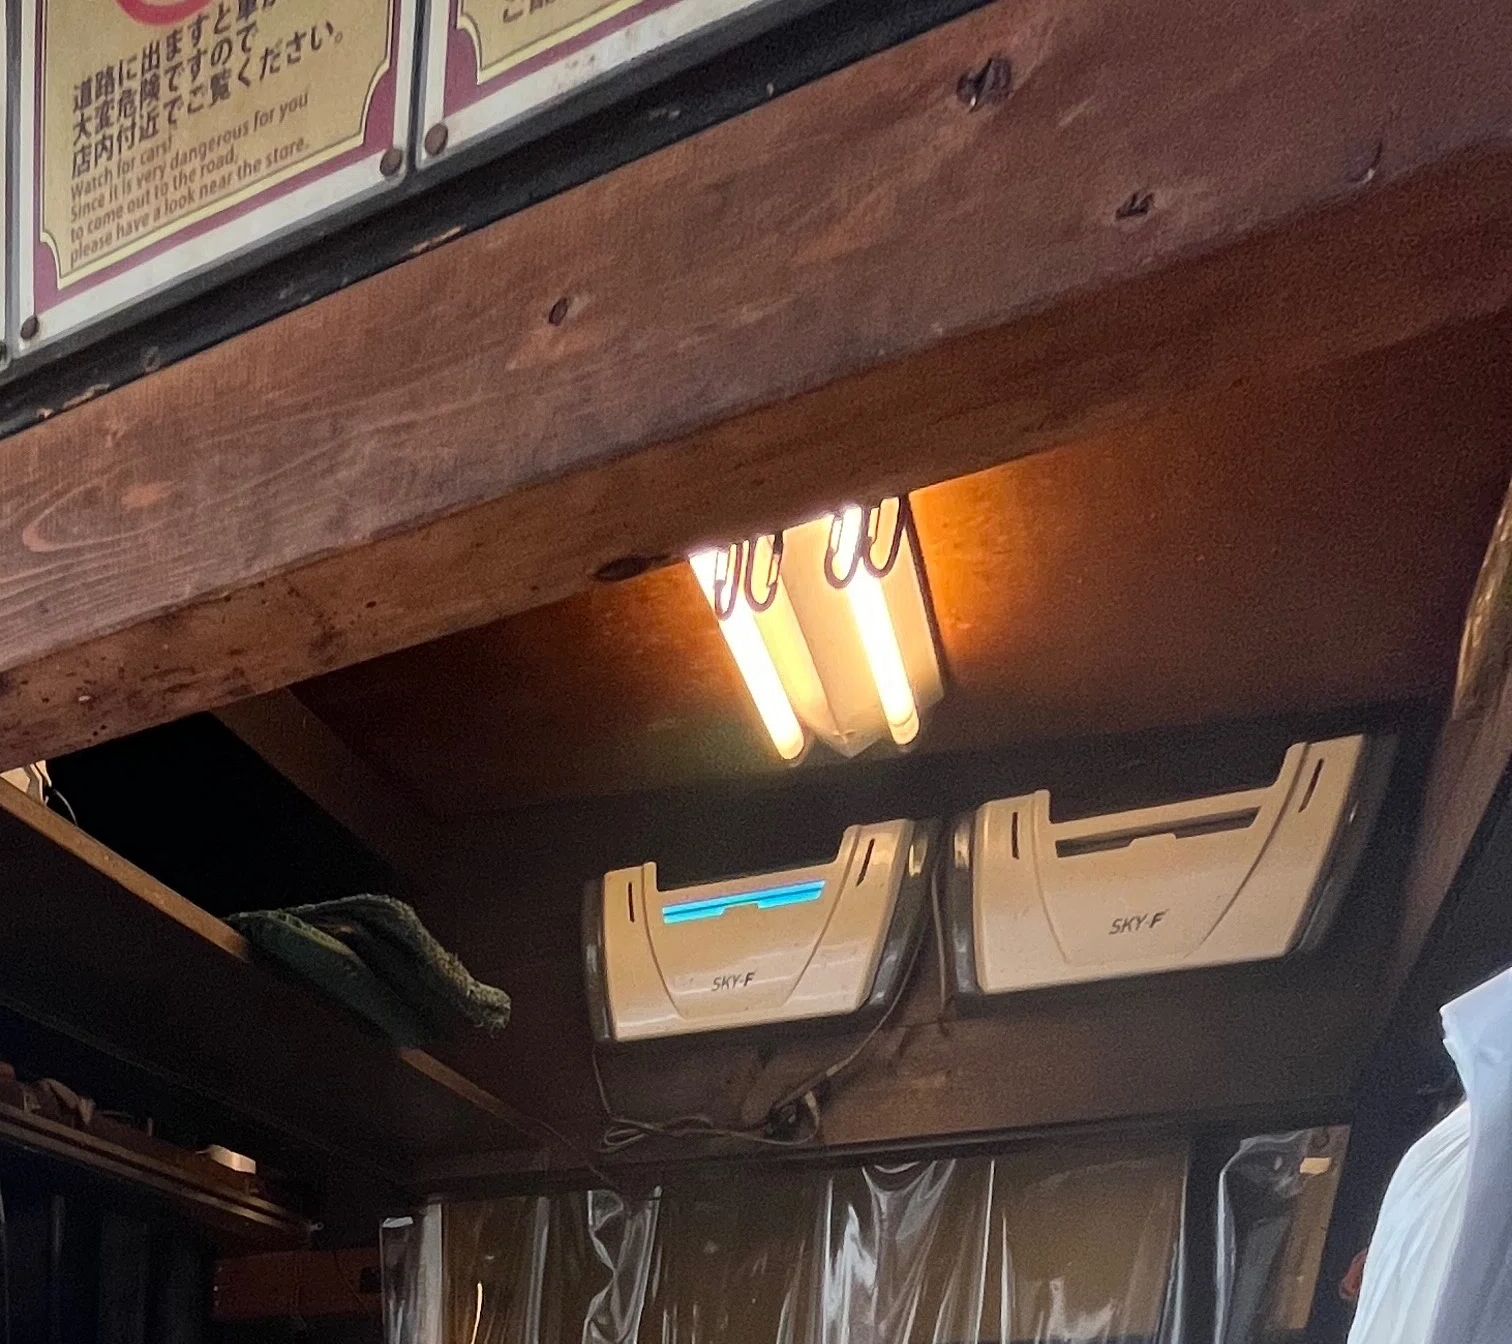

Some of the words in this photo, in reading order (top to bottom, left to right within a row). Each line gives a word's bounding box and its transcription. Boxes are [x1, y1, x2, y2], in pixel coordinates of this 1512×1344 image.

[71, 194, 105, 224] Since
[109, 183, 119, 204] it
[121, 178, 133, 198] is
[137, 163, 167, 188] very
[170, 120, 249, 171] dangerous
[253, 109, 276, 134] for
[279, 89, 309, 124] you
[71, 165, 113, 200] Watch
[117, 157, 135, 177] for
[71, 226, 84, 244] to
[87, 204, 123, 234] come
[127, 193, 151, 214] out
[155, 182, 169, 200] to
[173, 171, 197, 192] the
[71, 231, 113, 269] please
[117, 216, 150, 241] have
[164, 188, 196, 216] look
[199, 171, 234, 199] near
[237, 156, 262, 181] the
[1108, 908, 1170, 935] SKY-F
[710, 970, 758, 992] SKY-F
